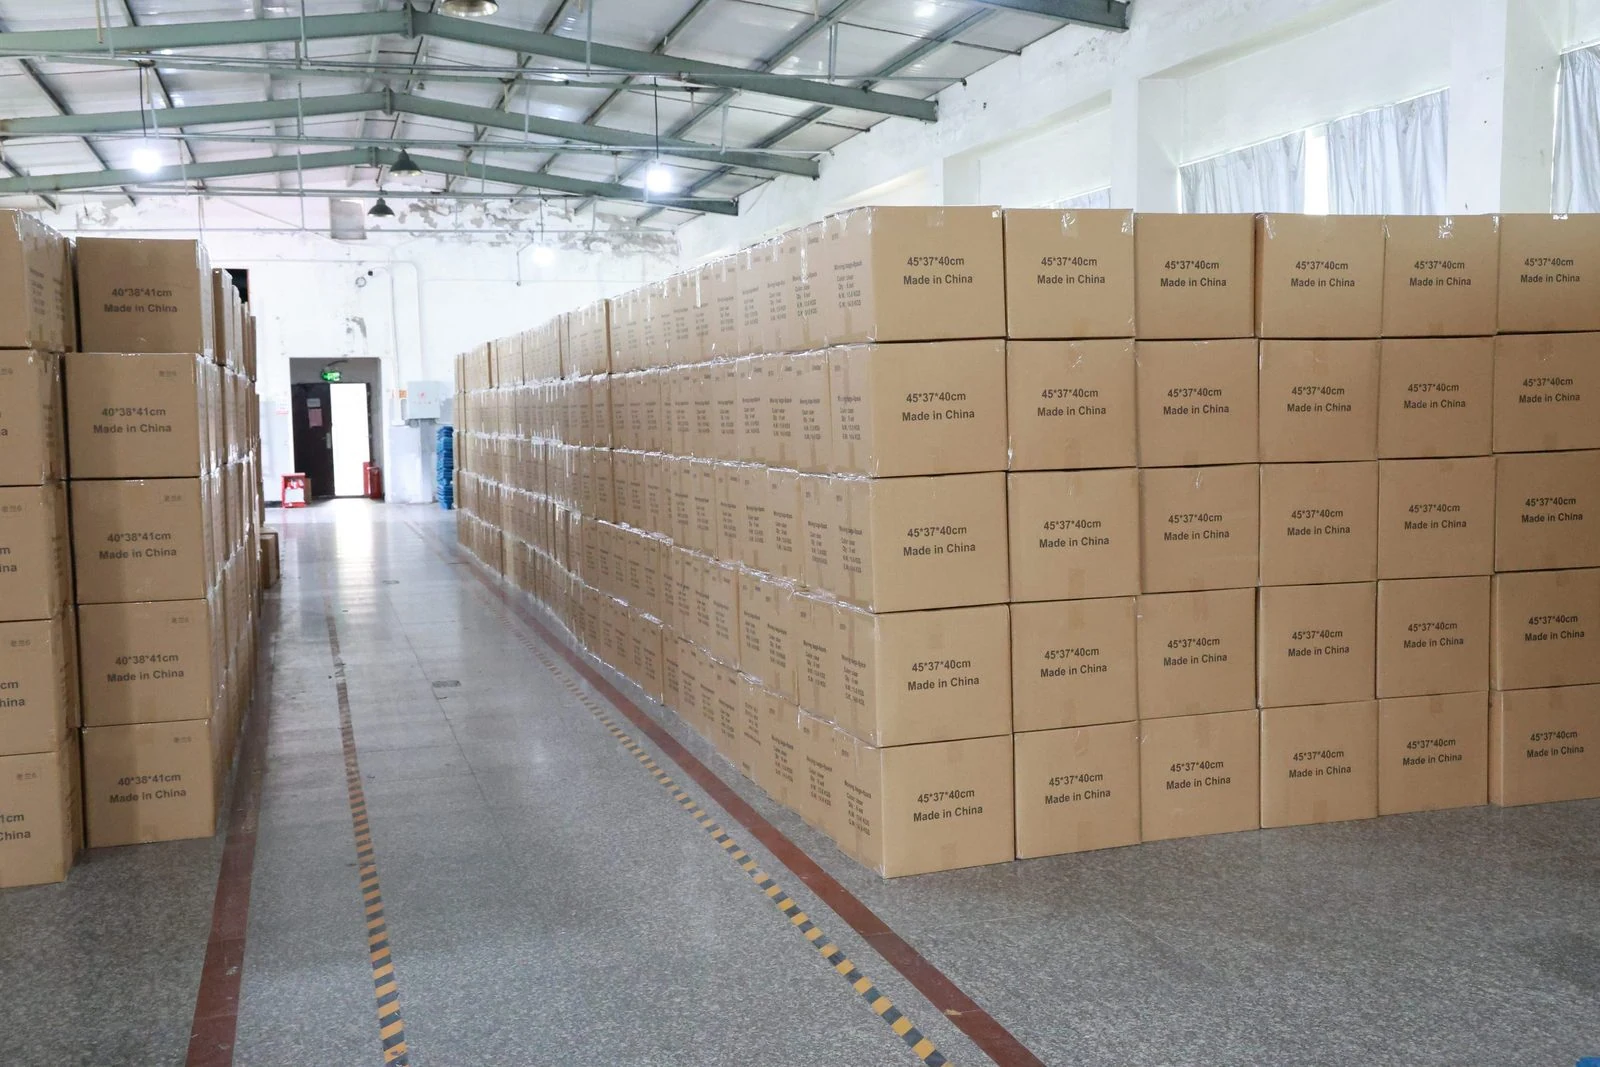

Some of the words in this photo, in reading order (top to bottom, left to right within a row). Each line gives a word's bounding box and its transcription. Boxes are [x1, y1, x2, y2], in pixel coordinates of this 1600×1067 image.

[903, 275, 931, 285] Made
[932, 275, 943, 285] in
[944, 273, 973, 284] China
[1037, 274, 1064, 285] Made
[1065, 274, 1075, 284] in
[1077, 274, 1106, 284] China
[1160, 277, 1186, 287] Made
[1188, 278, 1198, 287] in
[1199, 277, 1227, 288] China
[1290, 277, 1316, 287] Made
[1317, 278, 1327, 287] in
[1328, 277, 1355, 288] China
[1409, 277, 1434, 287] Made
[1435, 277, 1444, 286] in
[1446, 276, 1472, 286] China
[1520, 274, 1544, 283] Made
[1545, 274, 1554, 283] in
[1555, 273, 1580, 284] China
[104, 303, 132, 313] Made
[134, 304, 145, 313] in
[147, 303, 178, 313] China
[1403, 399, 1428, 409] Made
[1429, 400, 1439, 409] in
[1440, 398, 1466, 409] China
[1518, 394, 1542, 404] Made
[1544, 393, 1553, 403] in
[1554, 392, 1580, 402] China
[1037, 406, 1064, 417] Made
[1066, 406, 1076, 416] in
[1078, 405, 1106, 416] China
[1163, 405, 1189, 415] Made
[1191, 405, 1200, 415] in
[1202, 404, 1229, 414] China
[1287, 403, 1312, 413] Made
[1314, 403, 1323, 412] in
[1325, 402, 1352, 412] China
[902, 411, 930, 423] Made
[932, 410, 943, 421] in
[945, 409, 975, 420] China
[93, 424, 124, 434] Made
[126, 423, 137, 433] in
[139, 423, 172, 433] China
[1521, 514, 1545, 523] Made
[1547, 513, 1556, 522] in
[1557, 512, 1583, 522] China
[1287, 526, 1312, 536] Made
[1313, 525, 1323, 535] in
[1324, 525, 1351, 535] China
[1404, 520, 1428, 530] Made
[1430, 520, 1439, 529] in
[1441, 519, 1467, 529] China
[1164, 531, 1190, 541] Made
[1191, 530, 1201, 540] in
[1202, 529, 1230, 540] China
[1039, 538, 1066, 548] Made
[1068, 537, 1078, 547] in
[1080, 536, 1110, 546] China
[99, 549, 129, 560] Made
[131, 549, 143, 558] in
[144, 546, 177, 558] China
[903, 545, 931, 557] Made
[934, 544, 944, 555] in
[946, 542, 976, 554] China
[1524, 632, 1548, 642] Made
[1550, 631, 1558, 640] in
[1560, 629, 1585, 639] China
[1403, 639, 1427, 649] Made
[1429, 638, 1438, 648] in
[1439, 636, 1464, 647] China
[1288, 647, 1312, 657] Made
[1313, 646, 1323, 656] in
[1324, 645, 1350, 655] China
[1163, 656, 1188, 667] Made
[1190, 655, 1199, 665] in
[1201, 653, 1228, 664] China
[107, 672, 137, 683] Made
[139, 671, 150, 680] in
[152, 669, 185, 680] China
[1040, 667, 1066, 678] Made
[1068, 666, 1078, 676] in
[1079, 663, 1107, 674] China
[907, 679, 935, 691] Made
[938, 678, 948, 688] in
[950, 676, 980, 687] China
[1526, 748, 1549, 759] Made
[1550, 747, 1559, 756] in
[1560, 745, 1584, 756] China
[1402, 756, 1426, 767] Made
[1427, 755, 1436, 764] in
[1437, 753, 1463, 763] China
[1288, 768, 1313, 778] Made
[1315, 767, 1324, 776] in
[1325, 765, 1352, 775] China
[1166, 779, 1192, 791] Made
[1193, 778, 1203, 787] in
[1204, 776, 1231, 786] China
[109, 793, 139, 804] Made
[142, 791, 153, 801] in
[154, 788, 187, 799] China
[1045, 793, 1070, 805] Made
[1072, 792, 1082, 801] in
[1083, 789, 1111, 800] China
[913, 810, 940, 822] Made
[942, 809, 952, 819] in
[954, 805, 983, 817] China
